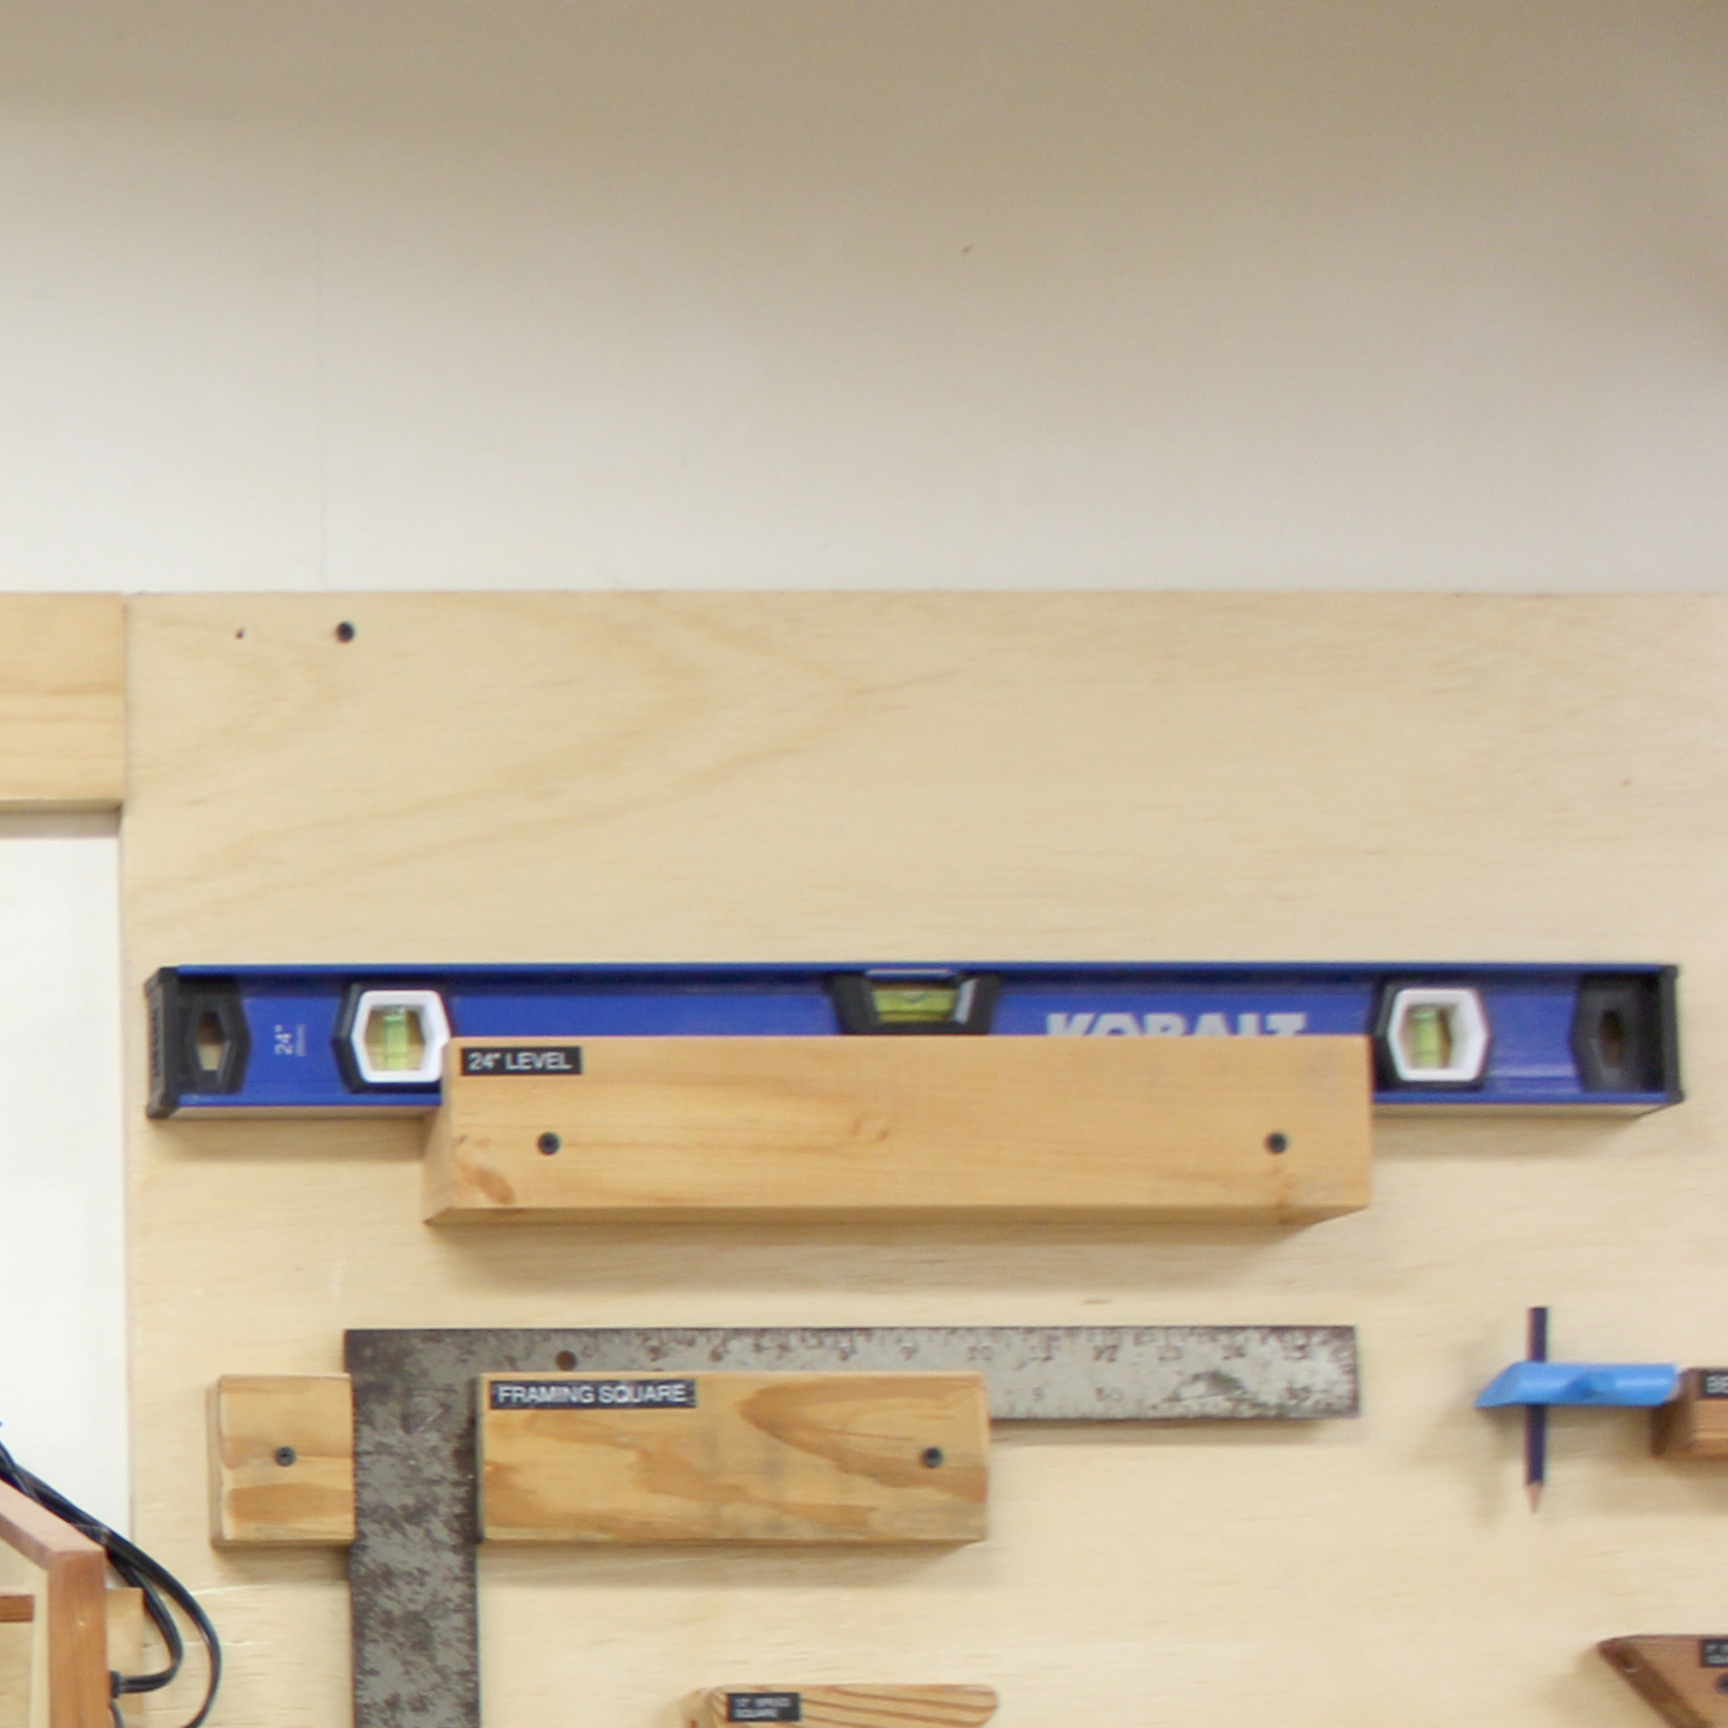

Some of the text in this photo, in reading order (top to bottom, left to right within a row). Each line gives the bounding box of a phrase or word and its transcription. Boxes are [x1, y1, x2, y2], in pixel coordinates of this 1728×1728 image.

[505, 1051, 573, 1070] LEVEL
[497, 1384, 686, 1403] FRAMING SQUARE
